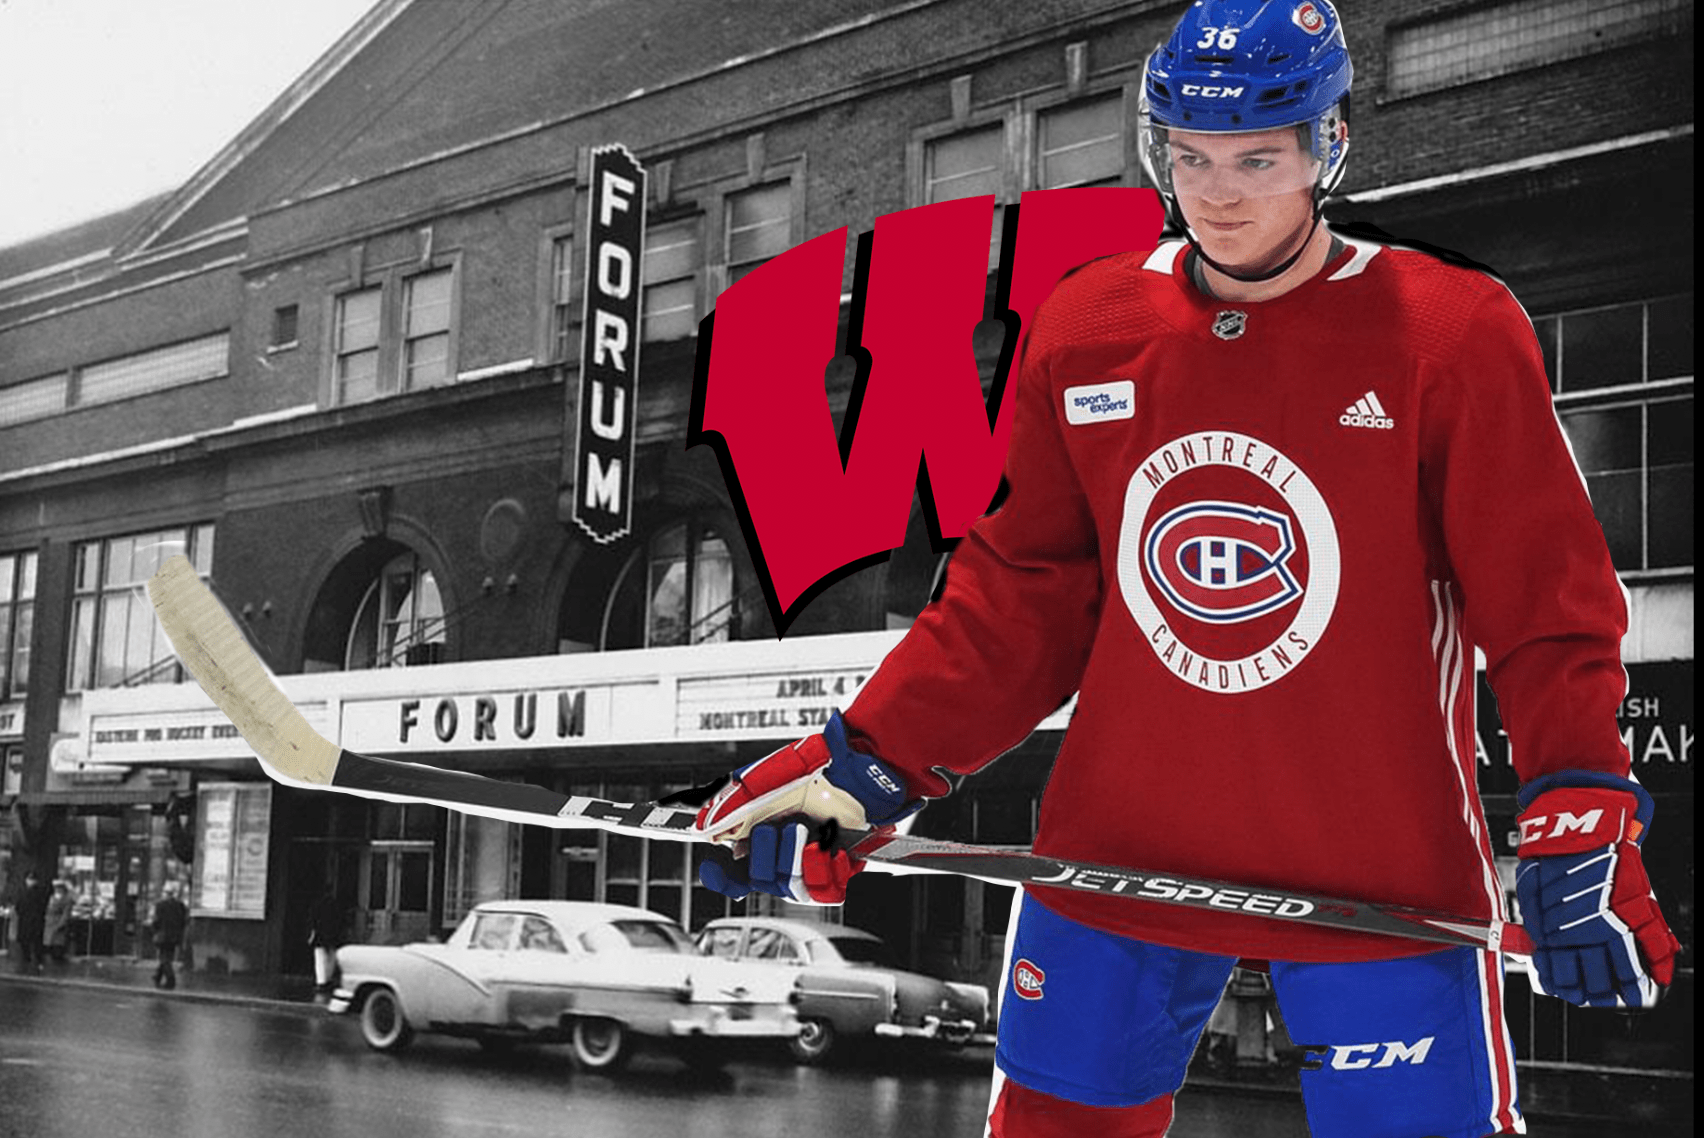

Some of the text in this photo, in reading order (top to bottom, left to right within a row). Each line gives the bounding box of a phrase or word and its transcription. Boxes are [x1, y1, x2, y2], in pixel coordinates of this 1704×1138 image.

[1197, 26, 1240, 50] 36
[1181, 84, 1244, 98] CCM
[585, 170, 635, 514] FORUM
[1073, 393, 1111, 408] sports
[1090, 399, 1128, 414] experts
[1339, 412, 1394, 429] adidas
[1142, 436, 1296, 494] MONTREAL
[1151, 623, 1309, 690] CANADIENS
[776, 677, 827, 698] APRIL
[399, 690, 586, 744] FORUM
[699, 709, 791, 730] MONTREAL
[868, 763, 901, 792] CCM
[1031, 863, 1315, 918] JETSPEED
